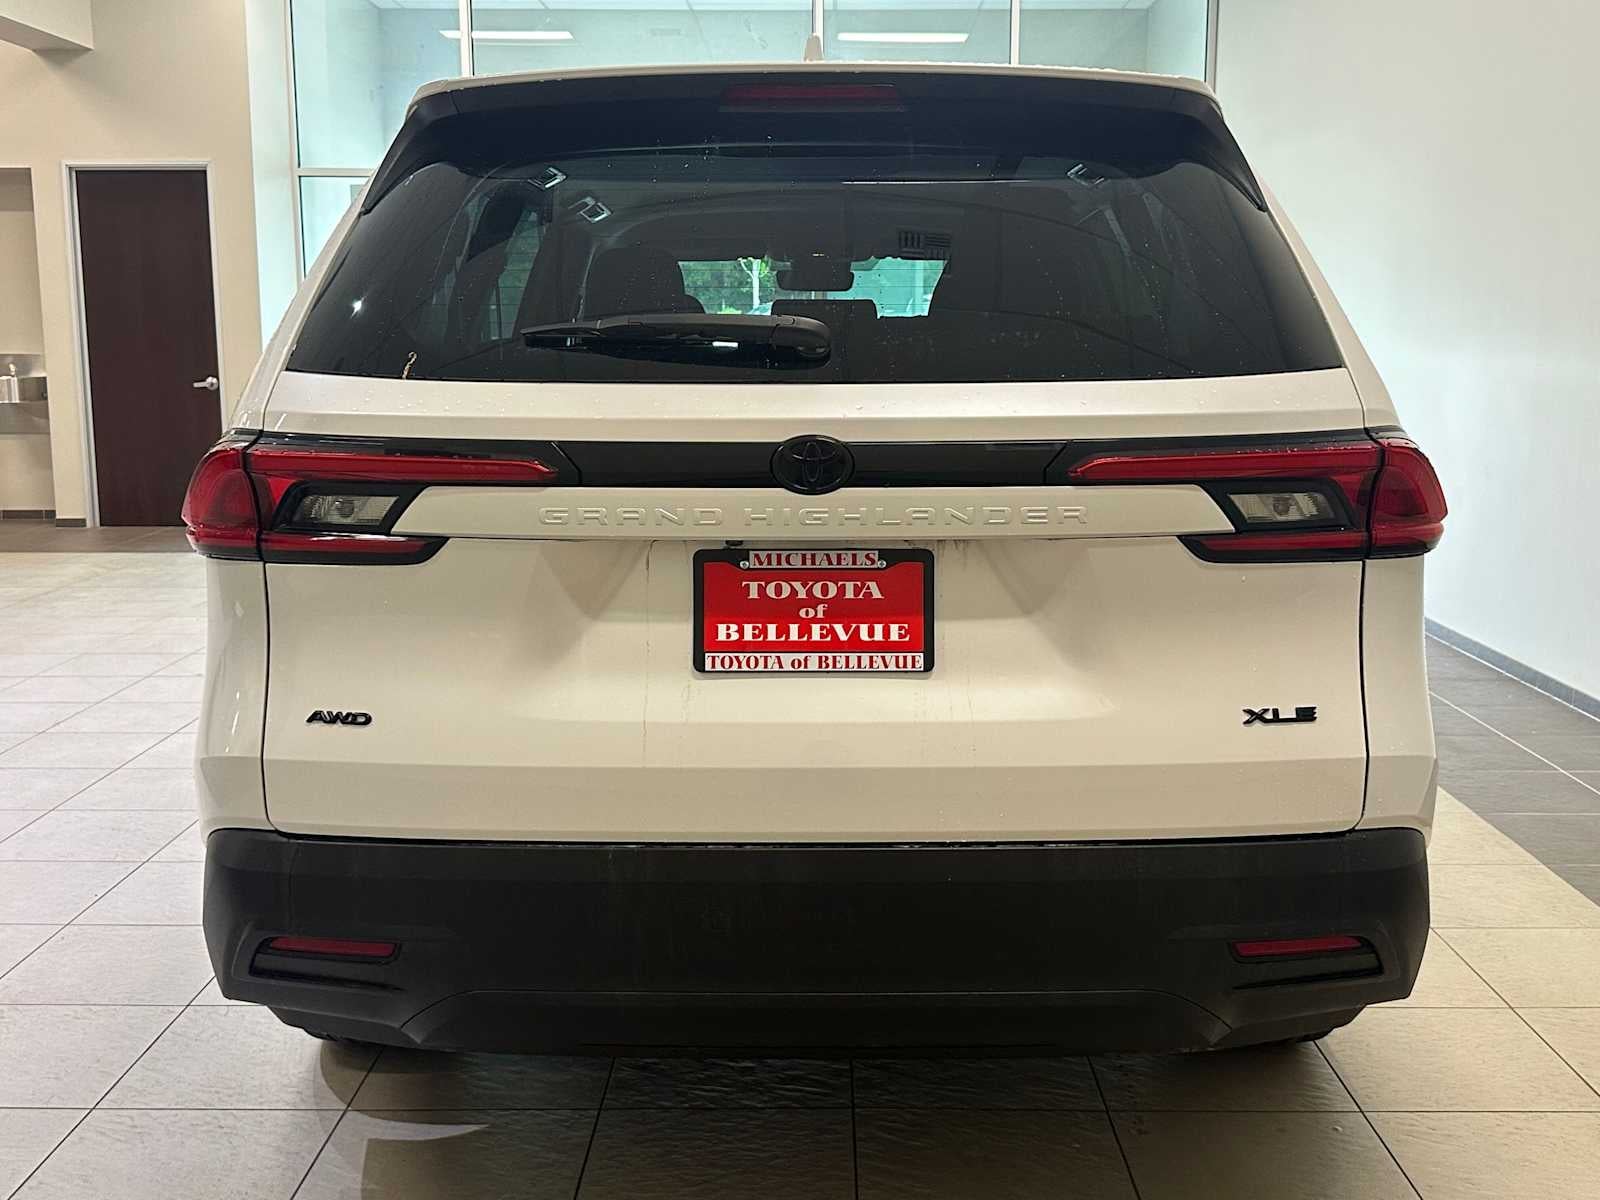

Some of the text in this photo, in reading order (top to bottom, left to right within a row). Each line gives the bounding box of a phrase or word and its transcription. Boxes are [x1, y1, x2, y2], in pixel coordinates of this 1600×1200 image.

[538, 505, 1089, 526] GRAND HIGHLANDER
[753, 552, 878, 566] MICHAELS
[742, 581, 885, 599] TOYOTA
[799, 604, 828, 618] of
[715, 623, 910, 642] BELLEVUE
[706, 654, 922, 670] TOYOTA of BELLEVUE
[306, 710, 372, 726] AWD
[1242, 706, 1318, 724] XLE
